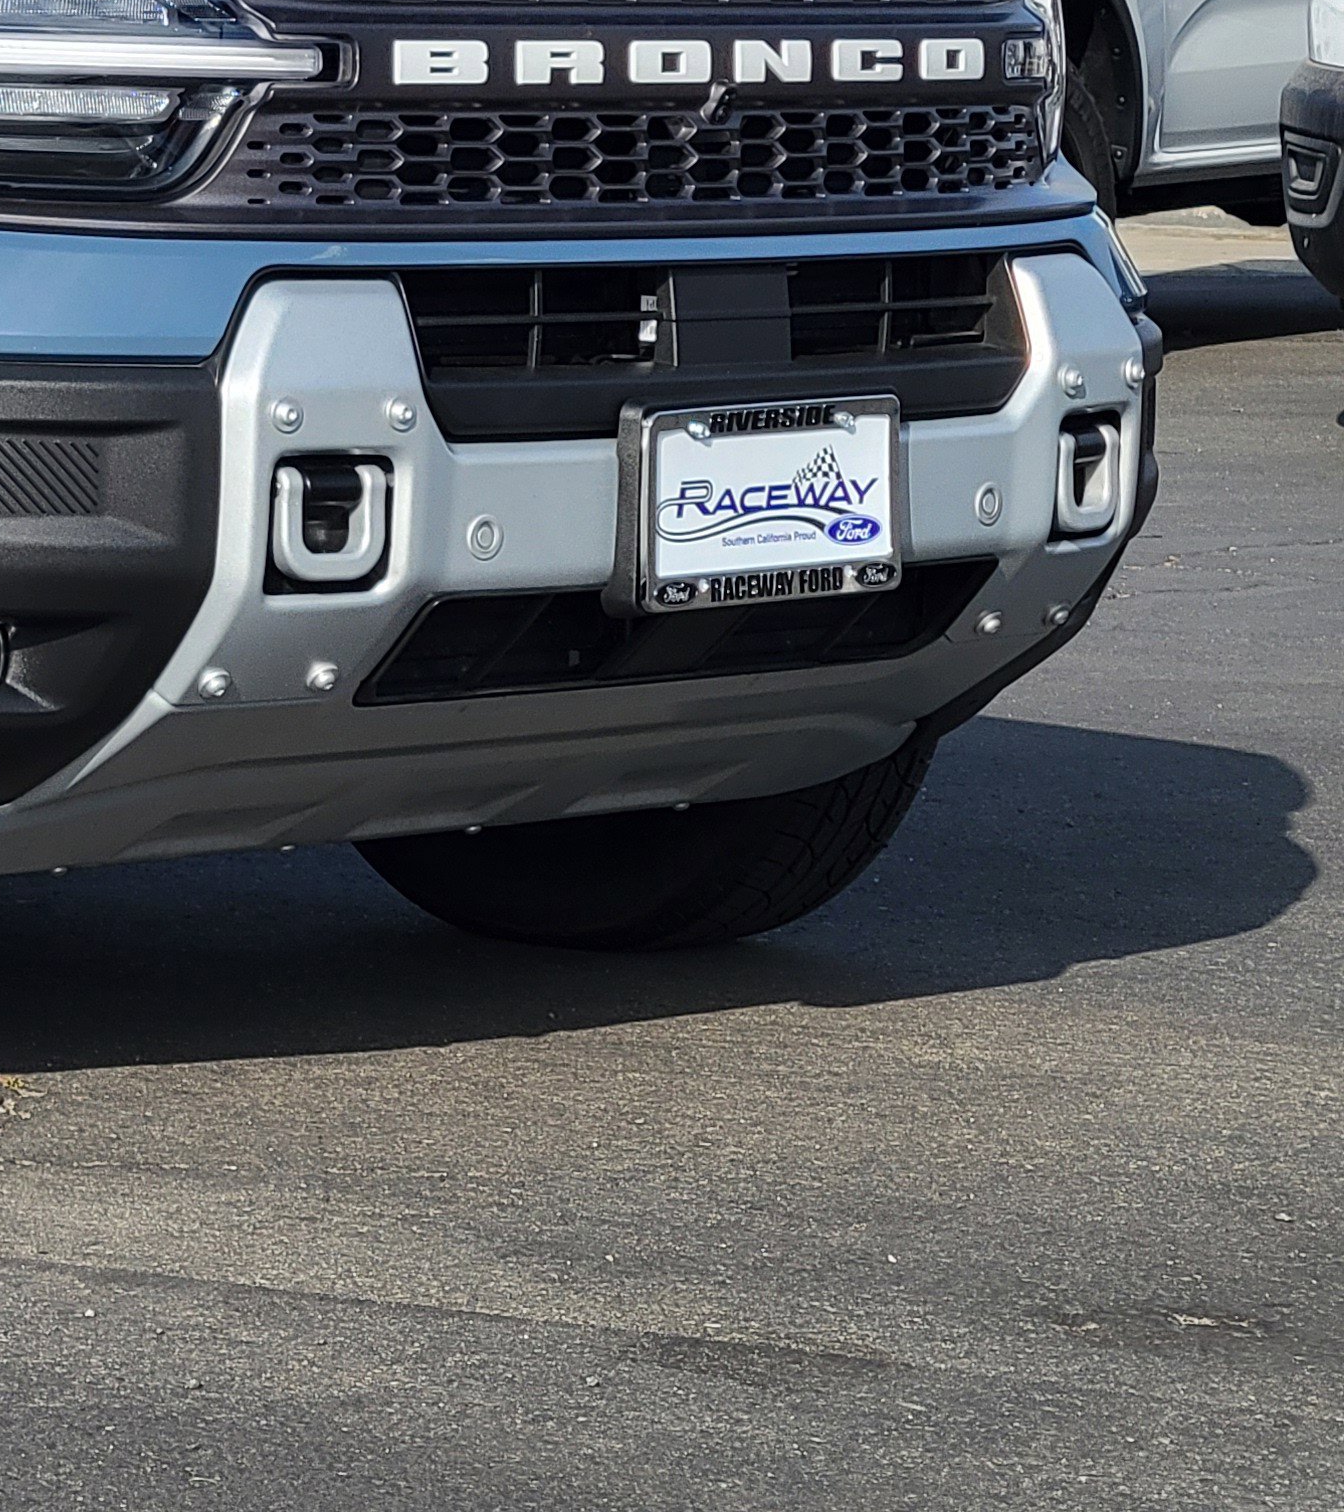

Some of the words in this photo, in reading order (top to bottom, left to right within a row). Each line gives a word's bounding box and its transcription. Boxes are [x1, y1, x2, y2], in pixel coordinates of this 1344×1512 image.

[392, 39, 985, 85] BRONCO
[710, 404, 837, 433] RIVERSIDE
[672, 478, 879, 519] RACEWAY
[722, 535, 756, 548] Southern
[756, 532, 793, 545] California
[794, 530, 817, 542] Proud
[710, 570, 796, 603] RACEWAY
[799, 567, 844, 593] FORD
